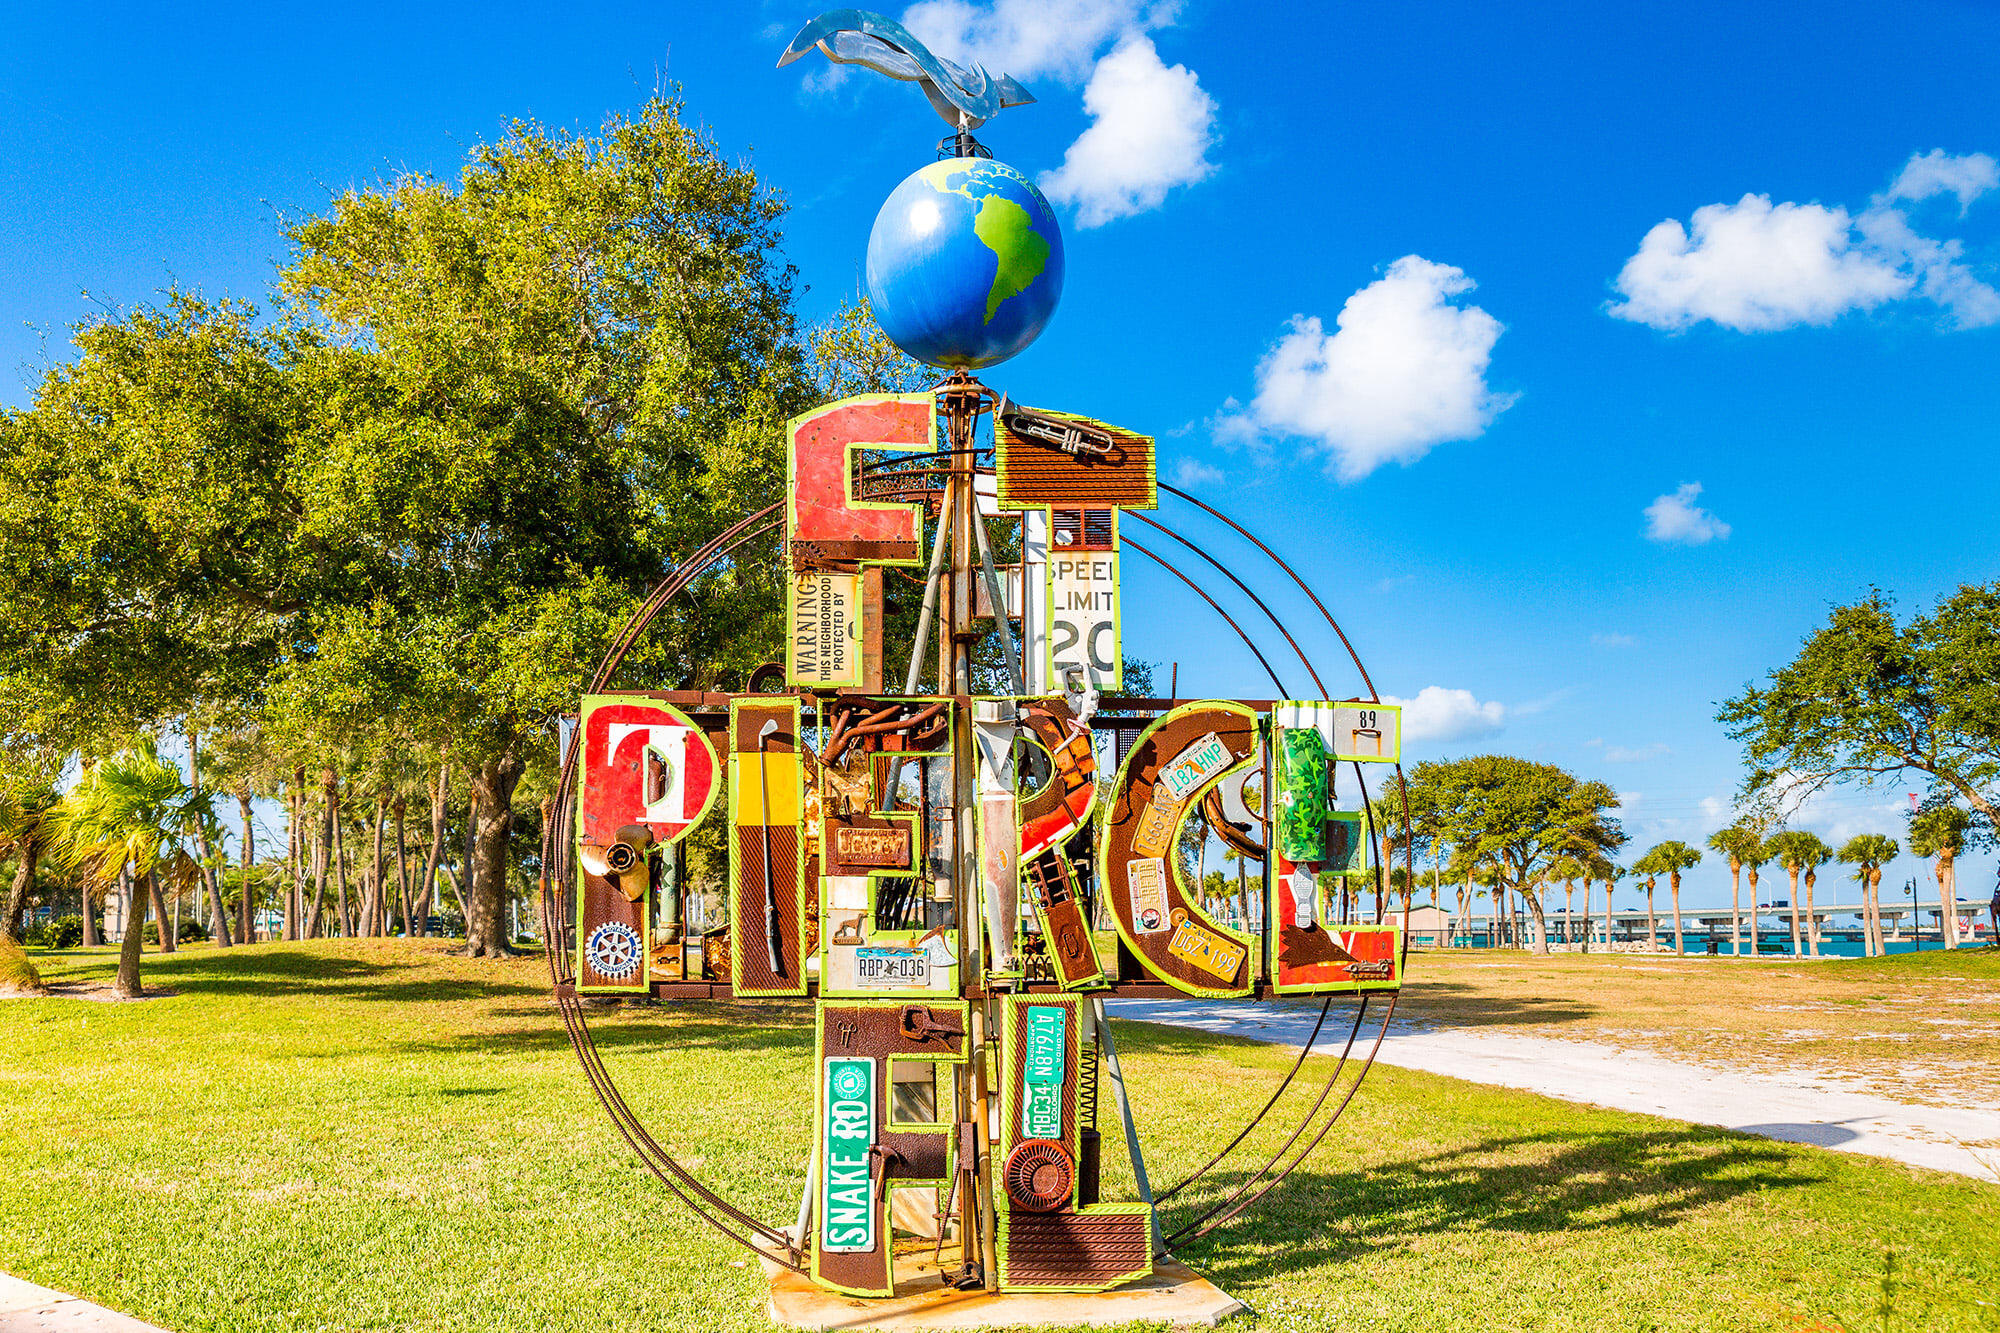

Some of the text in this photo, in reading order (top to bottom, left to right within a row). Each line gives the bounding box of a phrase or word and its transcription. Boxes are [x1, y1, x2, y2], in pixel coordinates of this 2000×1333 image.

[797, 583, 817, 675] WARNING
[821, 577, 832, 681] THIS NEIGHBORHOOD
[833, 592, 844, 671] PROTECTED BY
[1360, 710, 1377, 729] 89
[1169, 763, 1199, 792] 182
[1195, 742, 1222, 772] HNP
[859, 959, 924, 976] RBP 036
[1174, 930, 1237, 973] DGZ 199
[1034, 1014, 1055, 1076] A7648N
[829, 1101, 869, 1245] SNAKE RD
